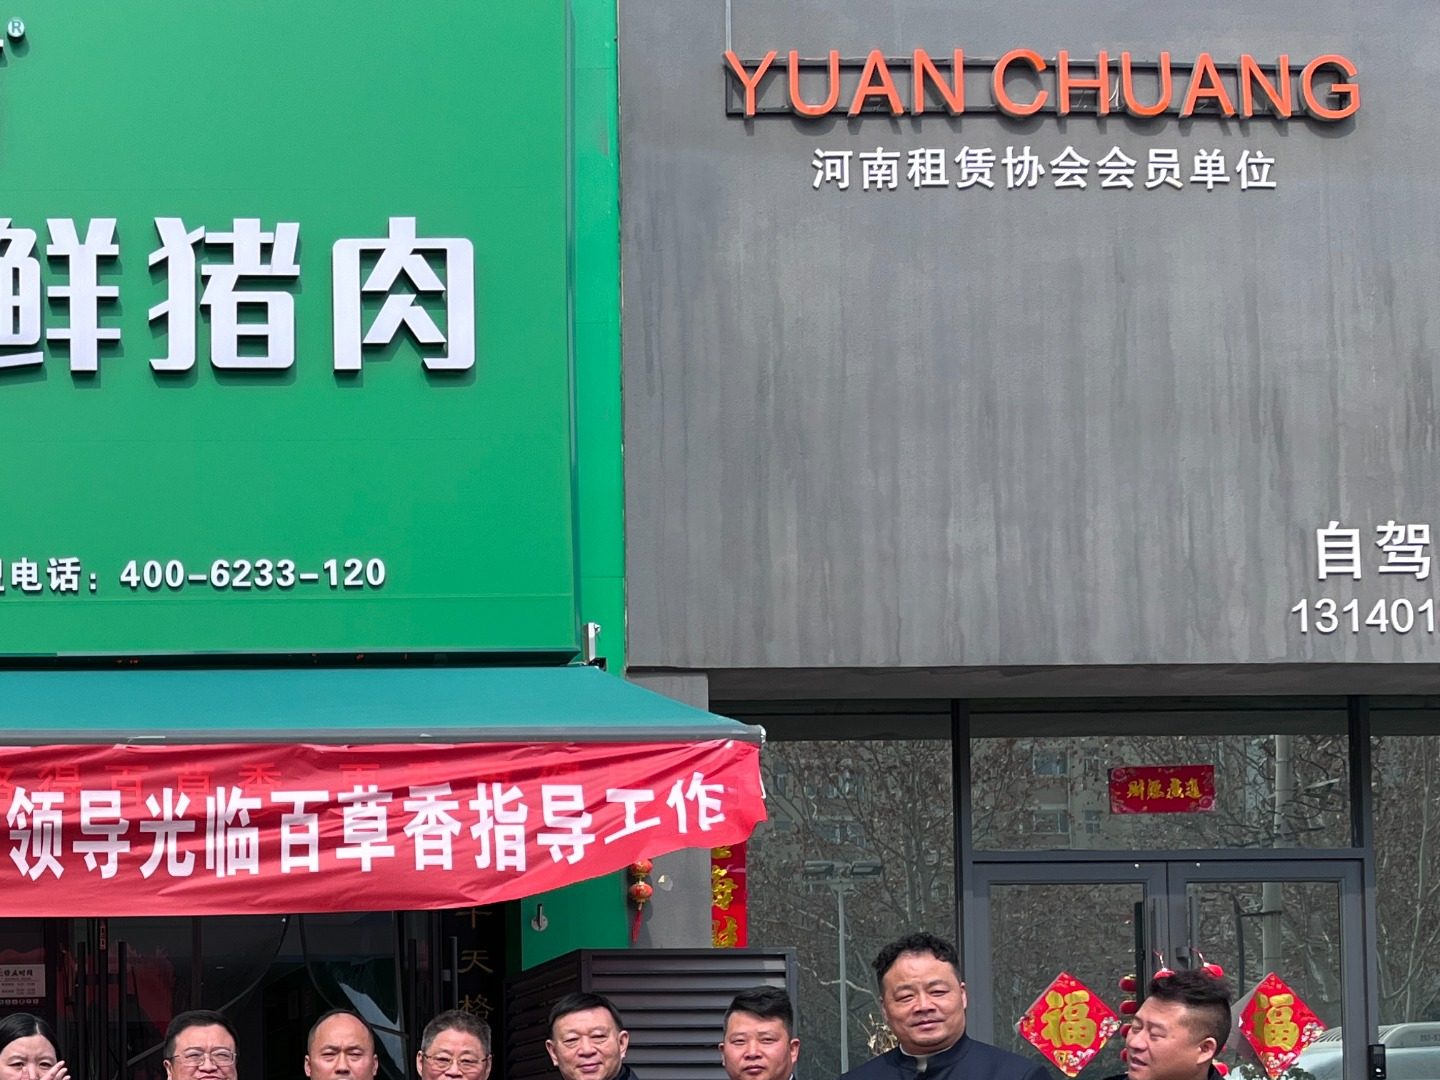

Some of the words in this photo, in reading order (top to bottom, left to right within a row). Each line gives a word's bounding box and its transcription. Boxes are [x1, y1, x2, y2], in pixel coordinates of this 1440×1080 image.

[723, 47, 964, 119] YUAN
[992, 48, 1360, 121] CHUANG
[812, 145, 1278, 191] 河南租赁协会会员单位
[1316, 520, 1432, 580] 自驾
[1292, 598, 1436, 634] 131401
[1041, 990, 1097, 1048] 福
[1252, 994, 1300, 1050] 福
